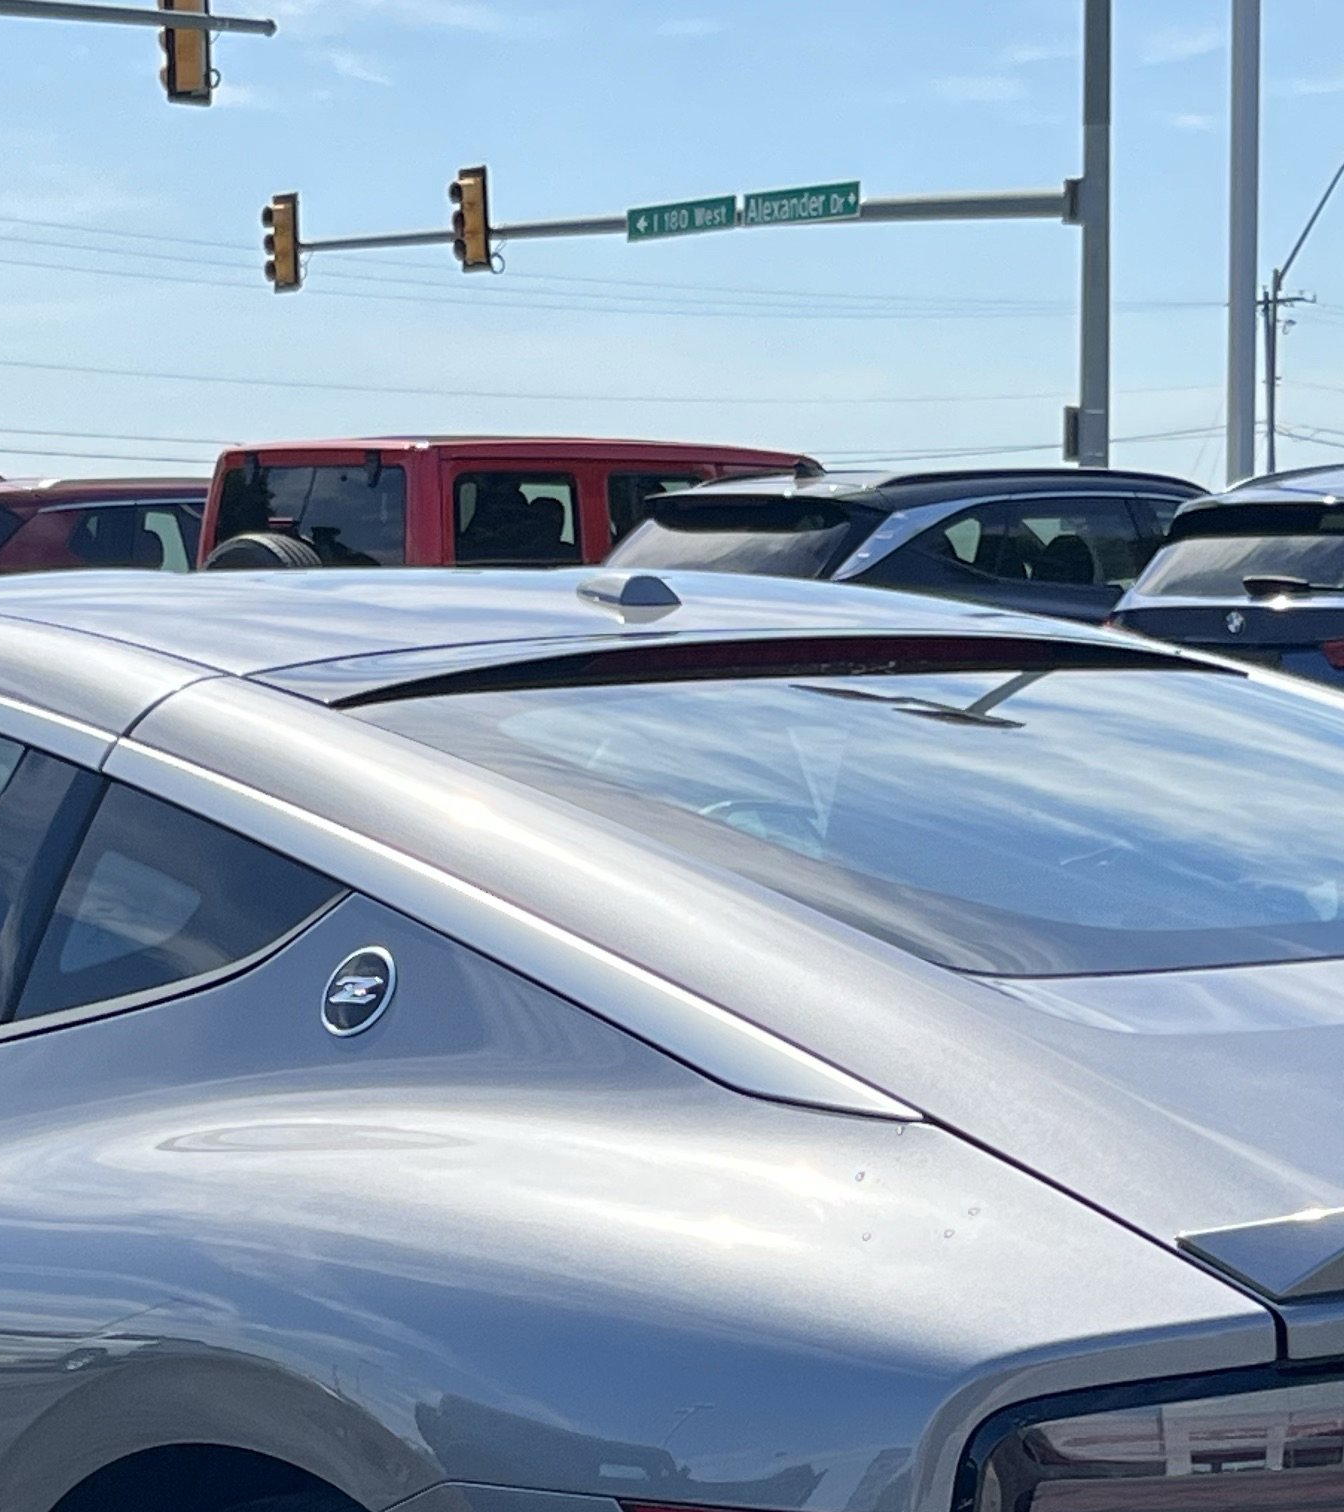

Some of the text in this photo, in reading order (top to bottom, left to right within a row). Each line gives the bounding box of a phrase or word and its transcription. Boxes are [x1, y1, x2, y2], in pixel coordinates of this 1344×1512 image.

[664, 209, 689, 231] 180
[694, 205, 727, 226] West
[746, 192, 845, 223] Alexander Dr
